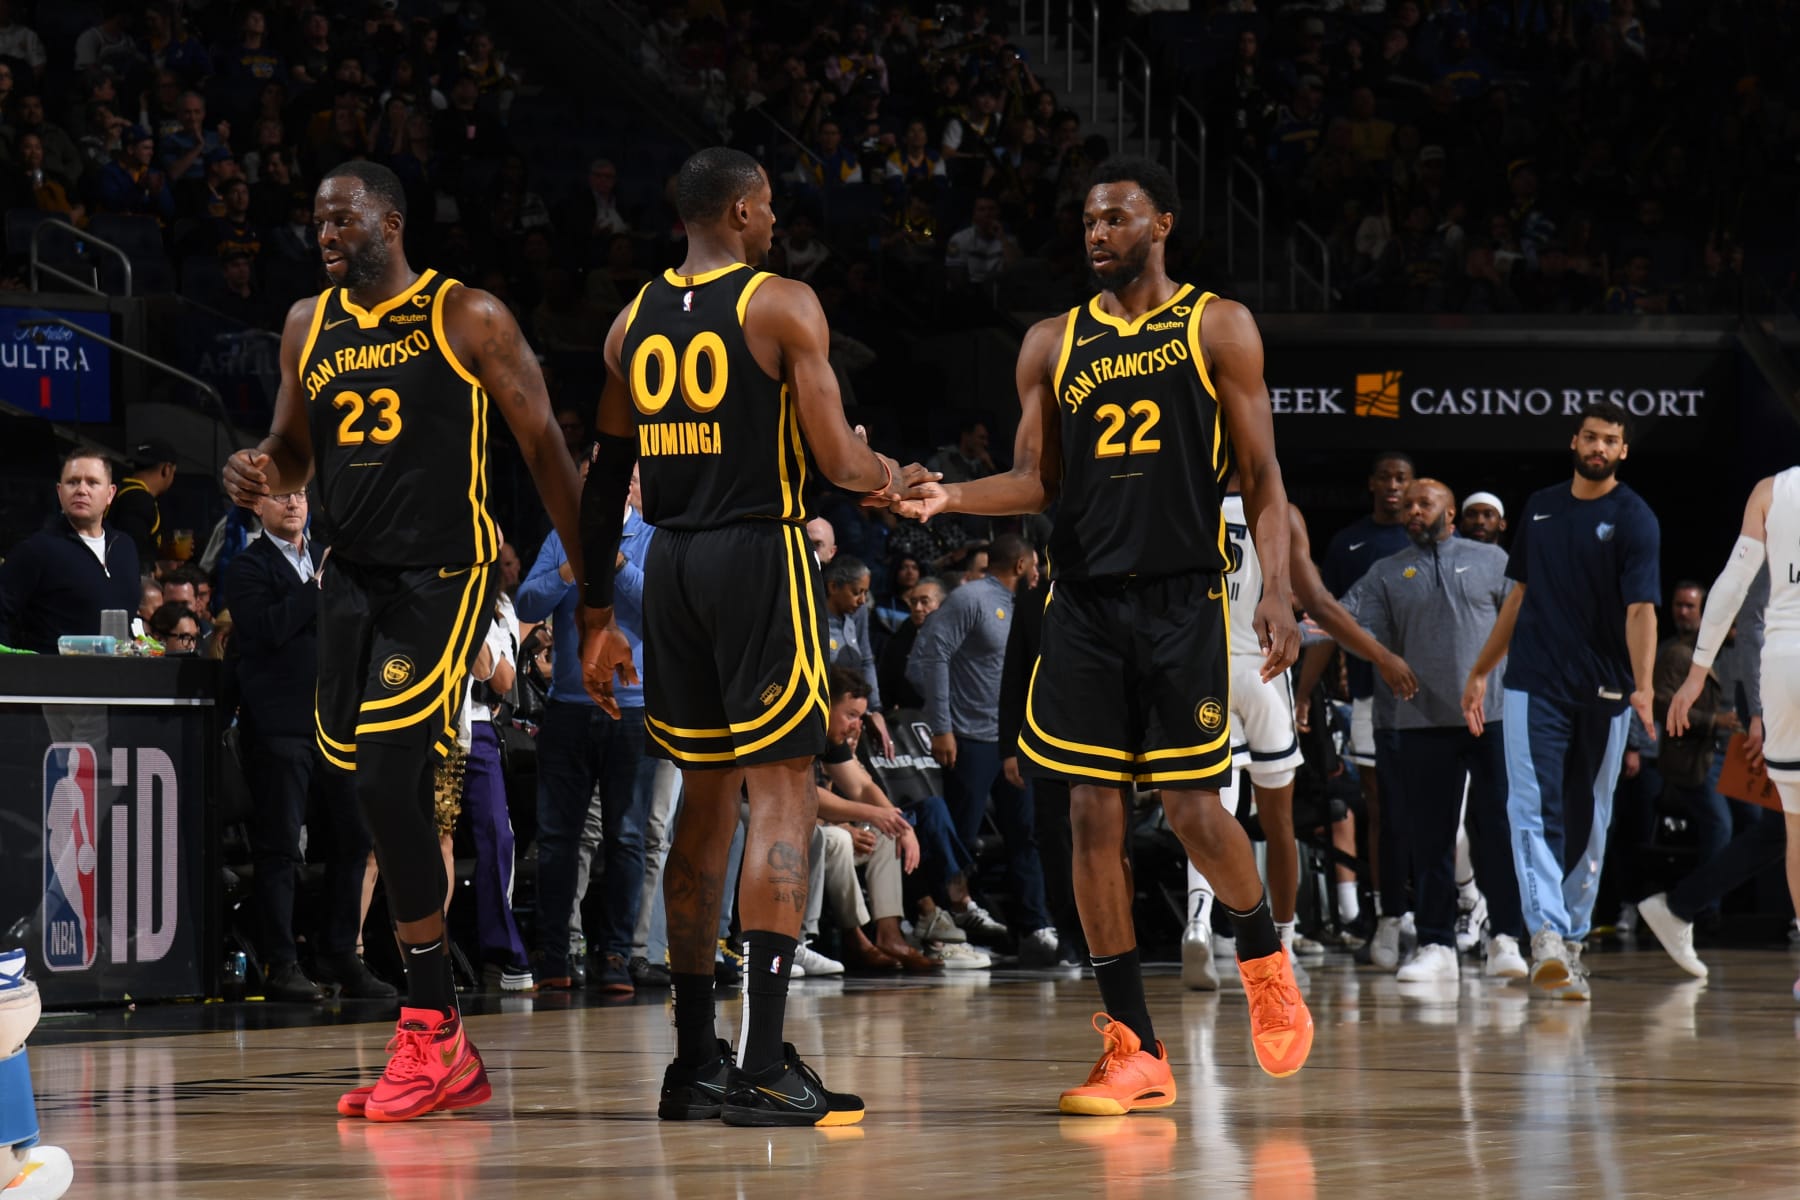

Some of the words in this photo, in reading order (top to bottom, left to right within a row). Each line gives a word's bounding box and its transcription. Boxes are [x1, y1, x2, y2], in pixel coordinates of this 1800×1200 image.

[390, 314, 427, 324] Rakuten
[1147, 321, 1184, 331] Rakuten
[1, 343, 91, 372] ULTRA
[306, 358, 336, 400] SAN
[335, 329, 430, 374] FRANCISCO
[630, 331, 728, 415] 00
[1065, 371, 1096, 414] SAN
[1091, 339, 1188, 384] FRANCISCO
[332, 388, 402, 446] 23
[1411, 388, 1552, 415] CASINO
[1562, 389, 1704, 416] RESORT
[638, 421, 722, 456] KUMINGA
[1094, 400, 1161, 459] 22
[51, 921, 77, 955] NBA
